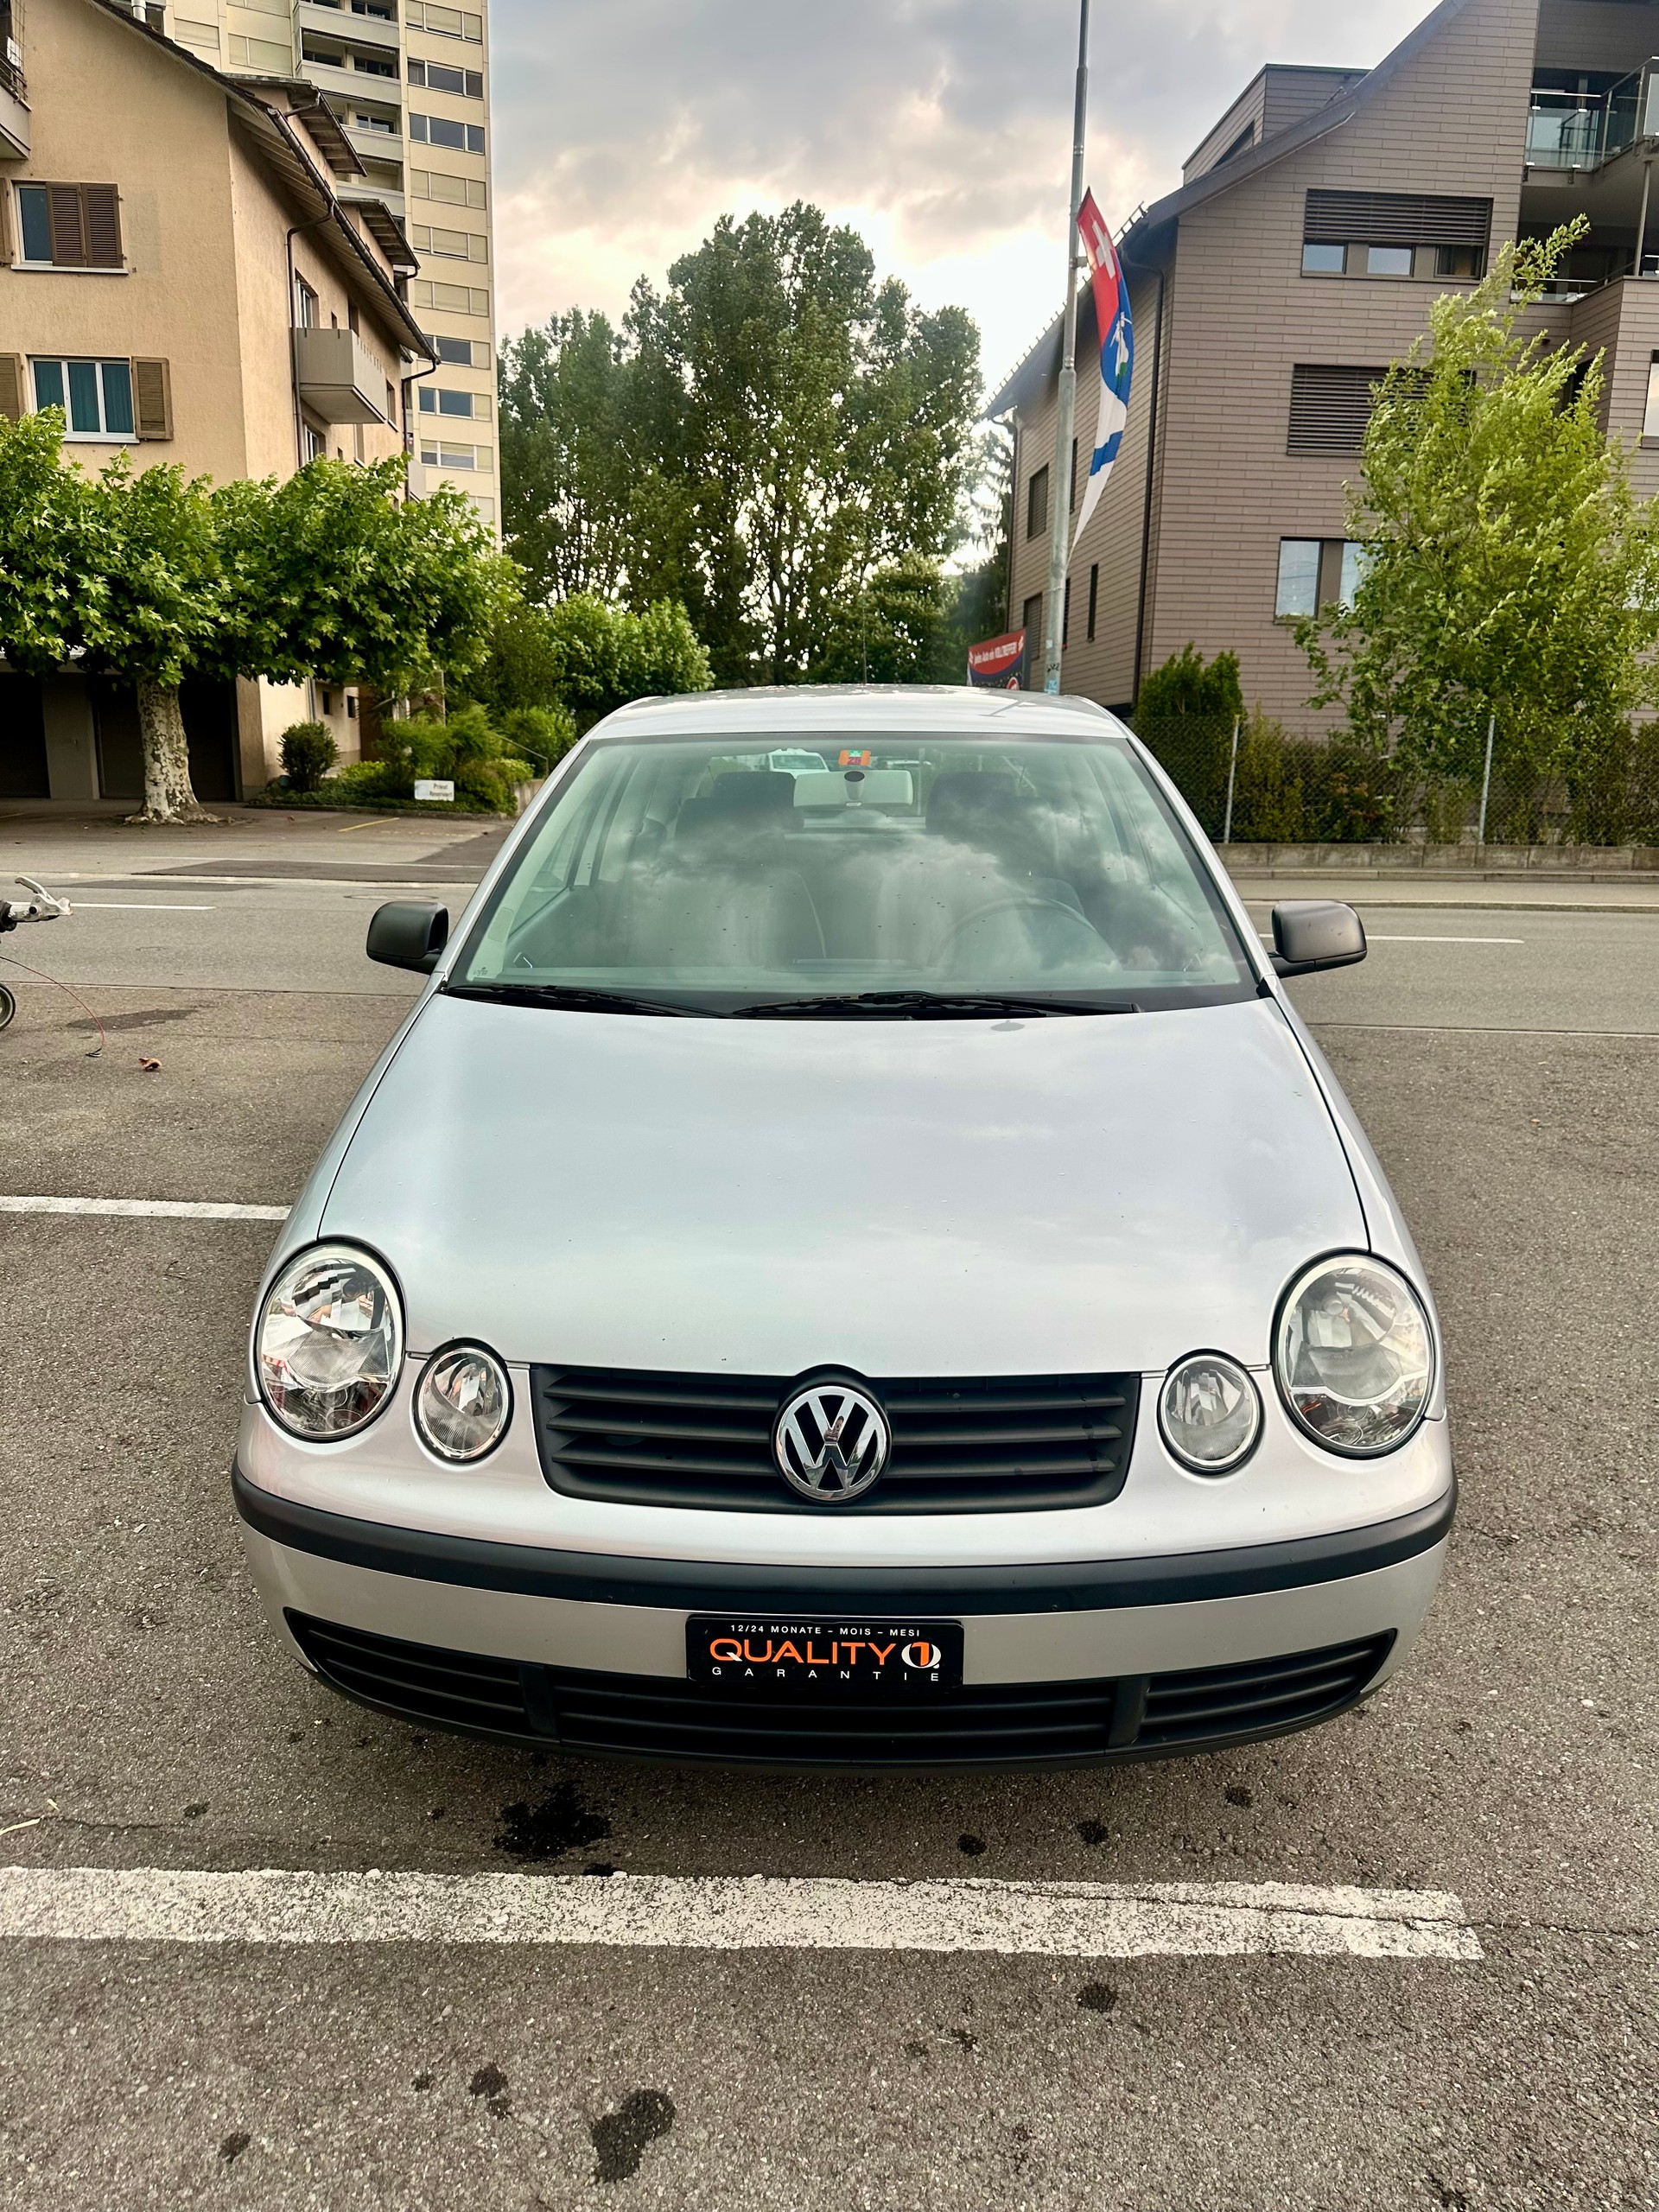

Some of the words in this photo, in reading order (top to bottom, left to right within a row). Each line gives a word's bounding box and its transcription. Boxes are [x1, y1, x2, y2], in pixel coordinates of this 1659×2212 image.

[730, 1624, 765, 1633] 12/24
[771, 1625, 822, 1634] MONATE
[839, 1627, 871, 1636] MOIS
[709, 1638, 897, 1665] QUALITY
[712, 1666, 939, 1681] GARANTIE
